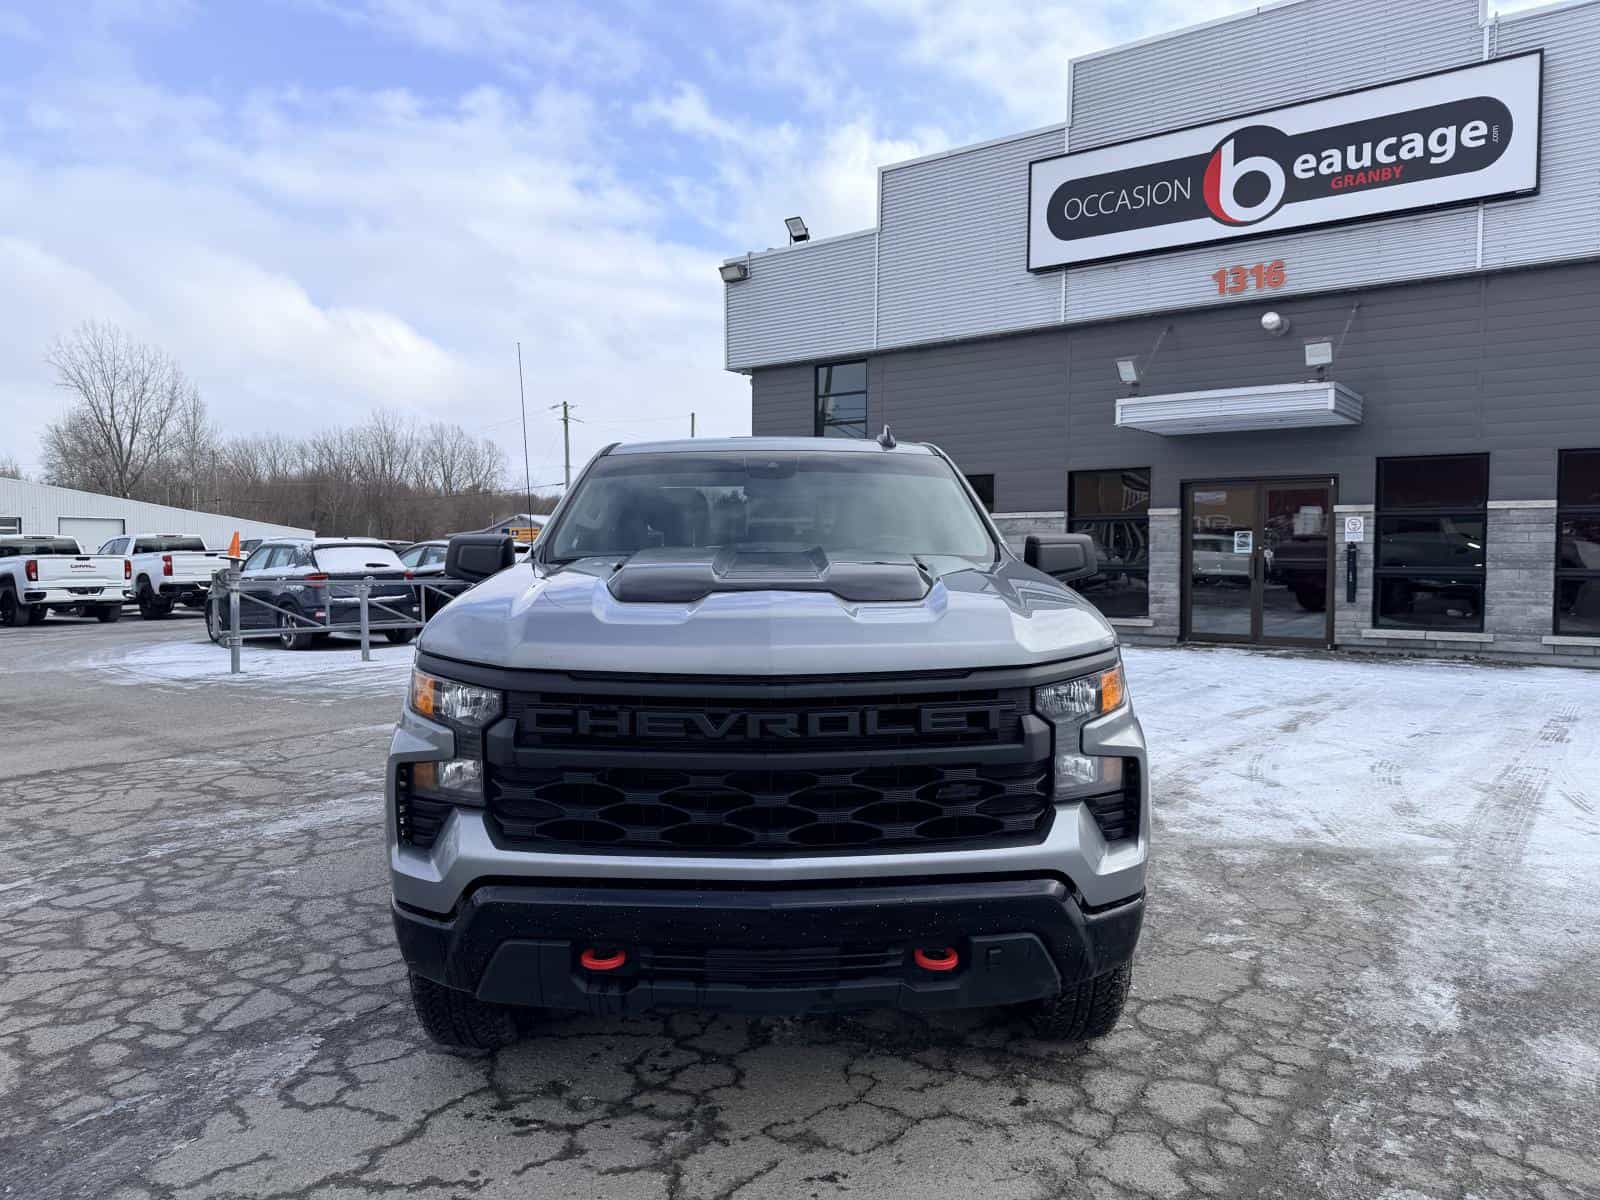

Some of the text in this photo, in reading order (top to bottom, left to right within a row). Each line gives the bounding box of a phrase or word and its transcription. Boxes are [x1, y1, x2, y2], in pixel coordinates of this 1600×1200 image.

[1330, 165, 1404, 190] GRANBY
[1064, 177, 1191, 221] OCCASION
[1211, 260, 1287, 295] 1316
[525, 703, 1017, 740] CHEVROLET
